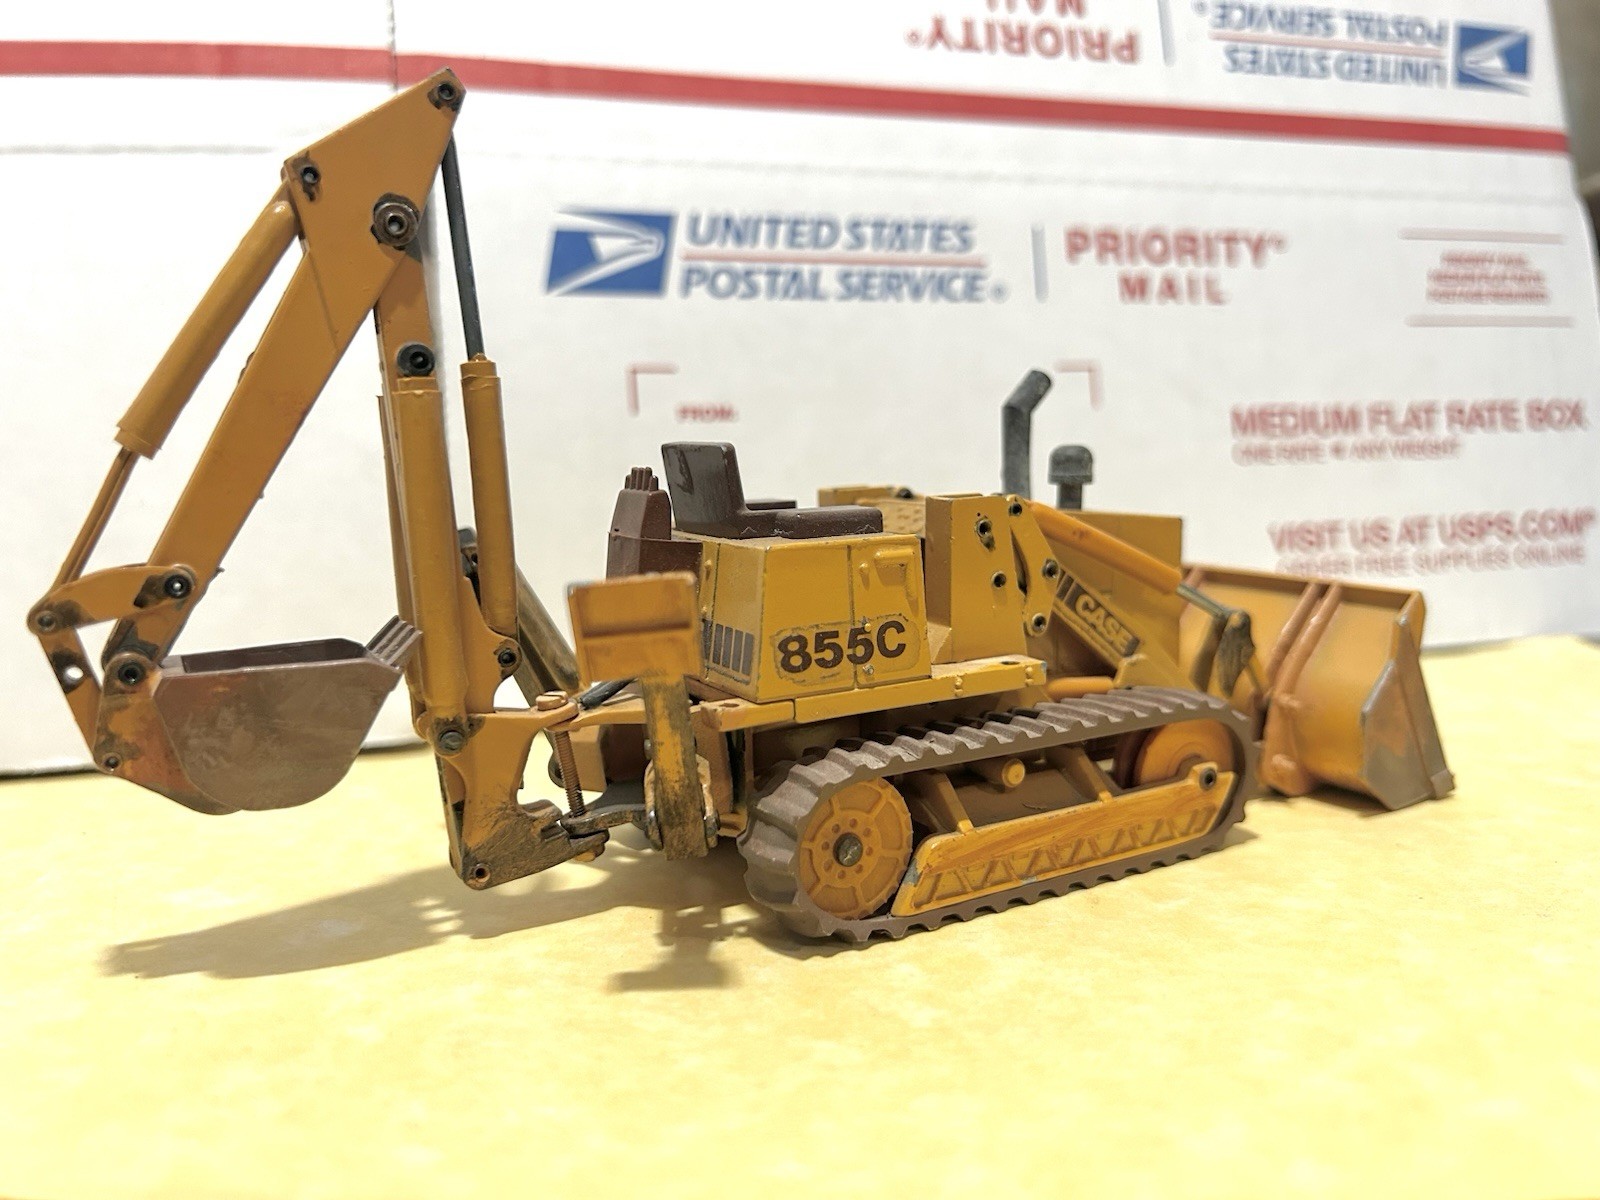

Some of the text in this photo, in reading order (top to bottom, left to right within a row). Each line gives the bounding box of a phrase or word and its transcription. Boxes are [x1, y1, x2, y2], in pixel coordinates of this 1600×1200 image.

[927, 14, 1142, 64] PRIORITY
[1222, 44, 1447, 88] UNITED STATES
[686, 213, 976, 255] UNITED STATES
[1063, 224, 1270, 270] PRIORITY
[680, 266, 987, 304] POSTAL SERVICE
[1117, 271, 1231, 305] MAIL
[1229, 397, 1587, 439] MEDIUM FLAT RATE BOX
[1267, 518, 1343, 553] VISIT
[1347, 515, 1393, 550] US
[1075, 593, 1133, 656] CASE
[777, 620, 906, 674] 855C
